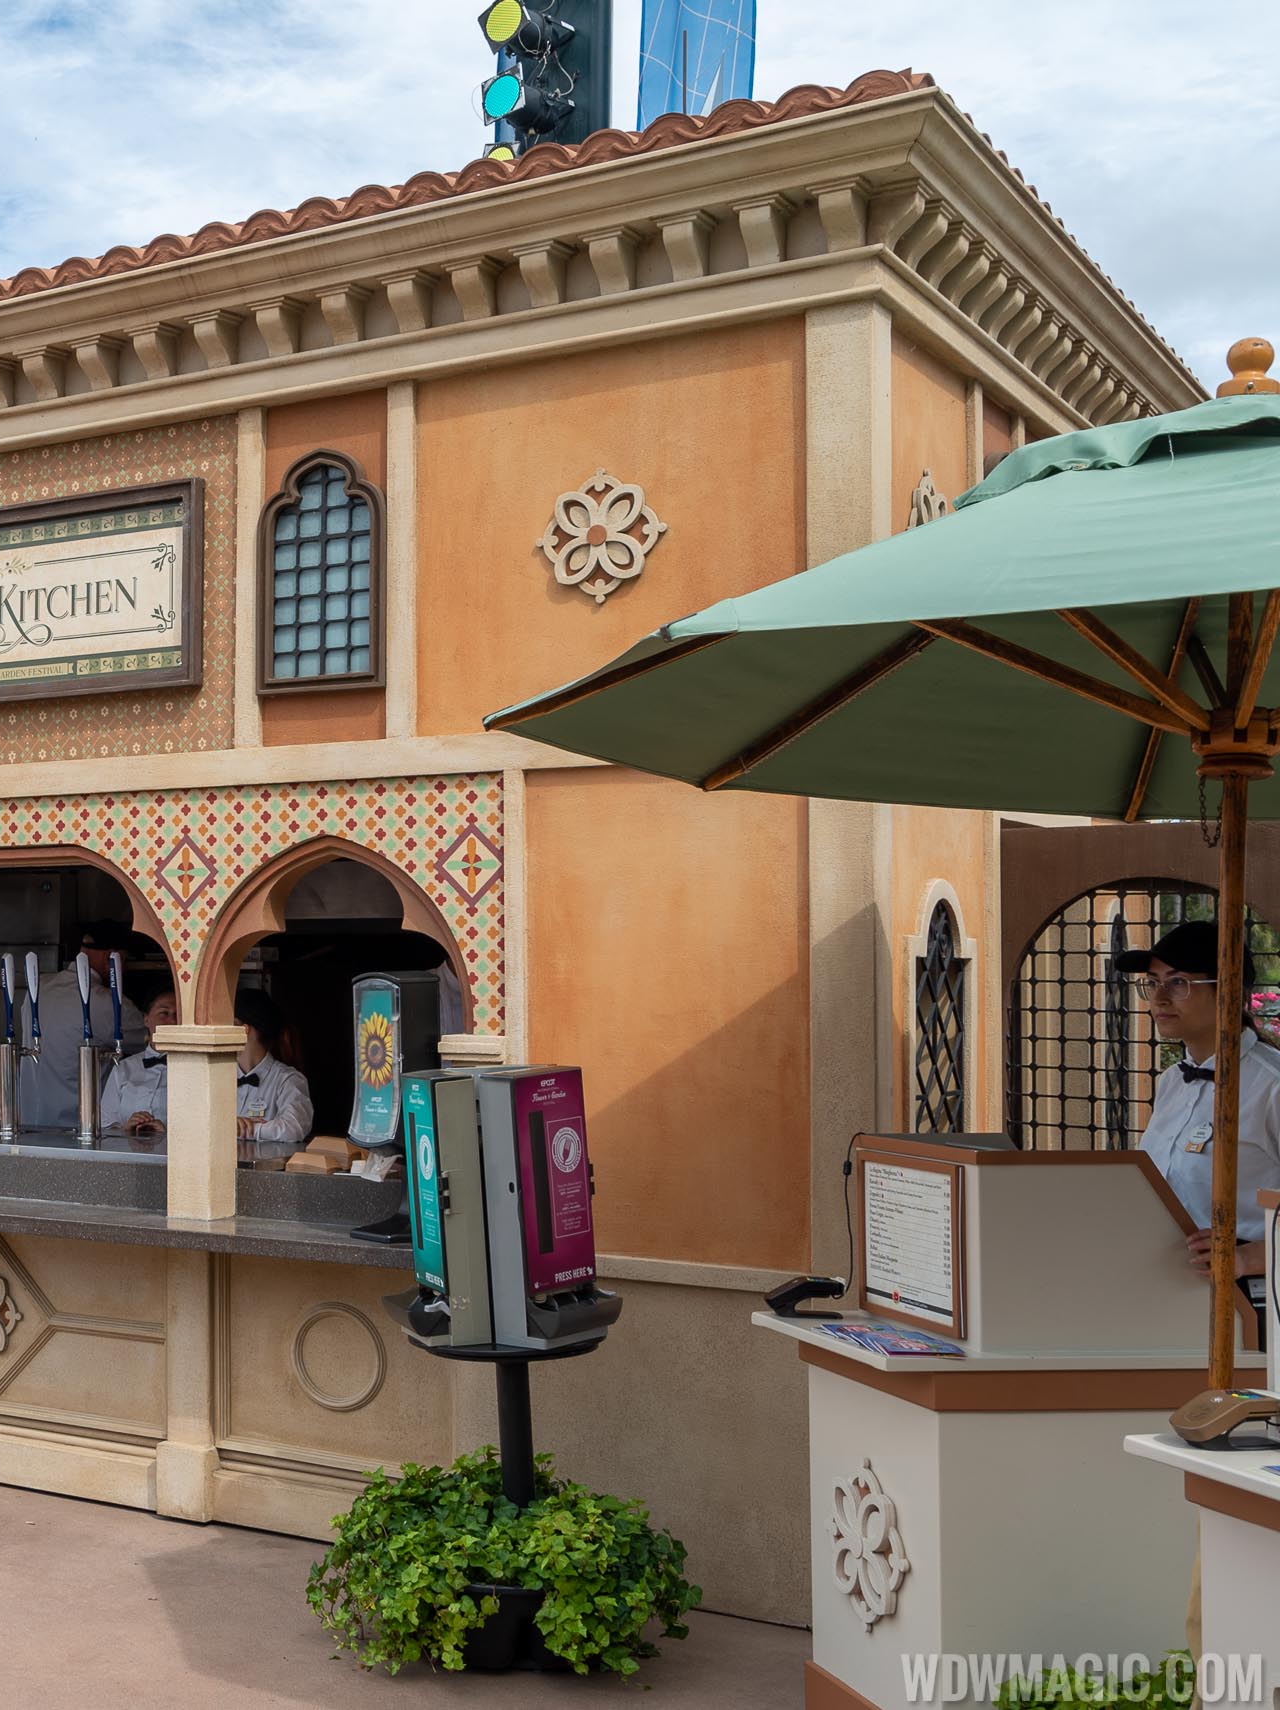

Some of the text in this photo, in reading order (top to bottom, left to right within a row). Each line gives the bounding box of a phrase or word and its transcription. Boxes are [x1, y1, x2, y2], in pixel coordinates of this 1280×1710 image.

[27, 665, 64, 677] FESTIVAL
[554, 1267, 587, 1283] PRESS HERE
